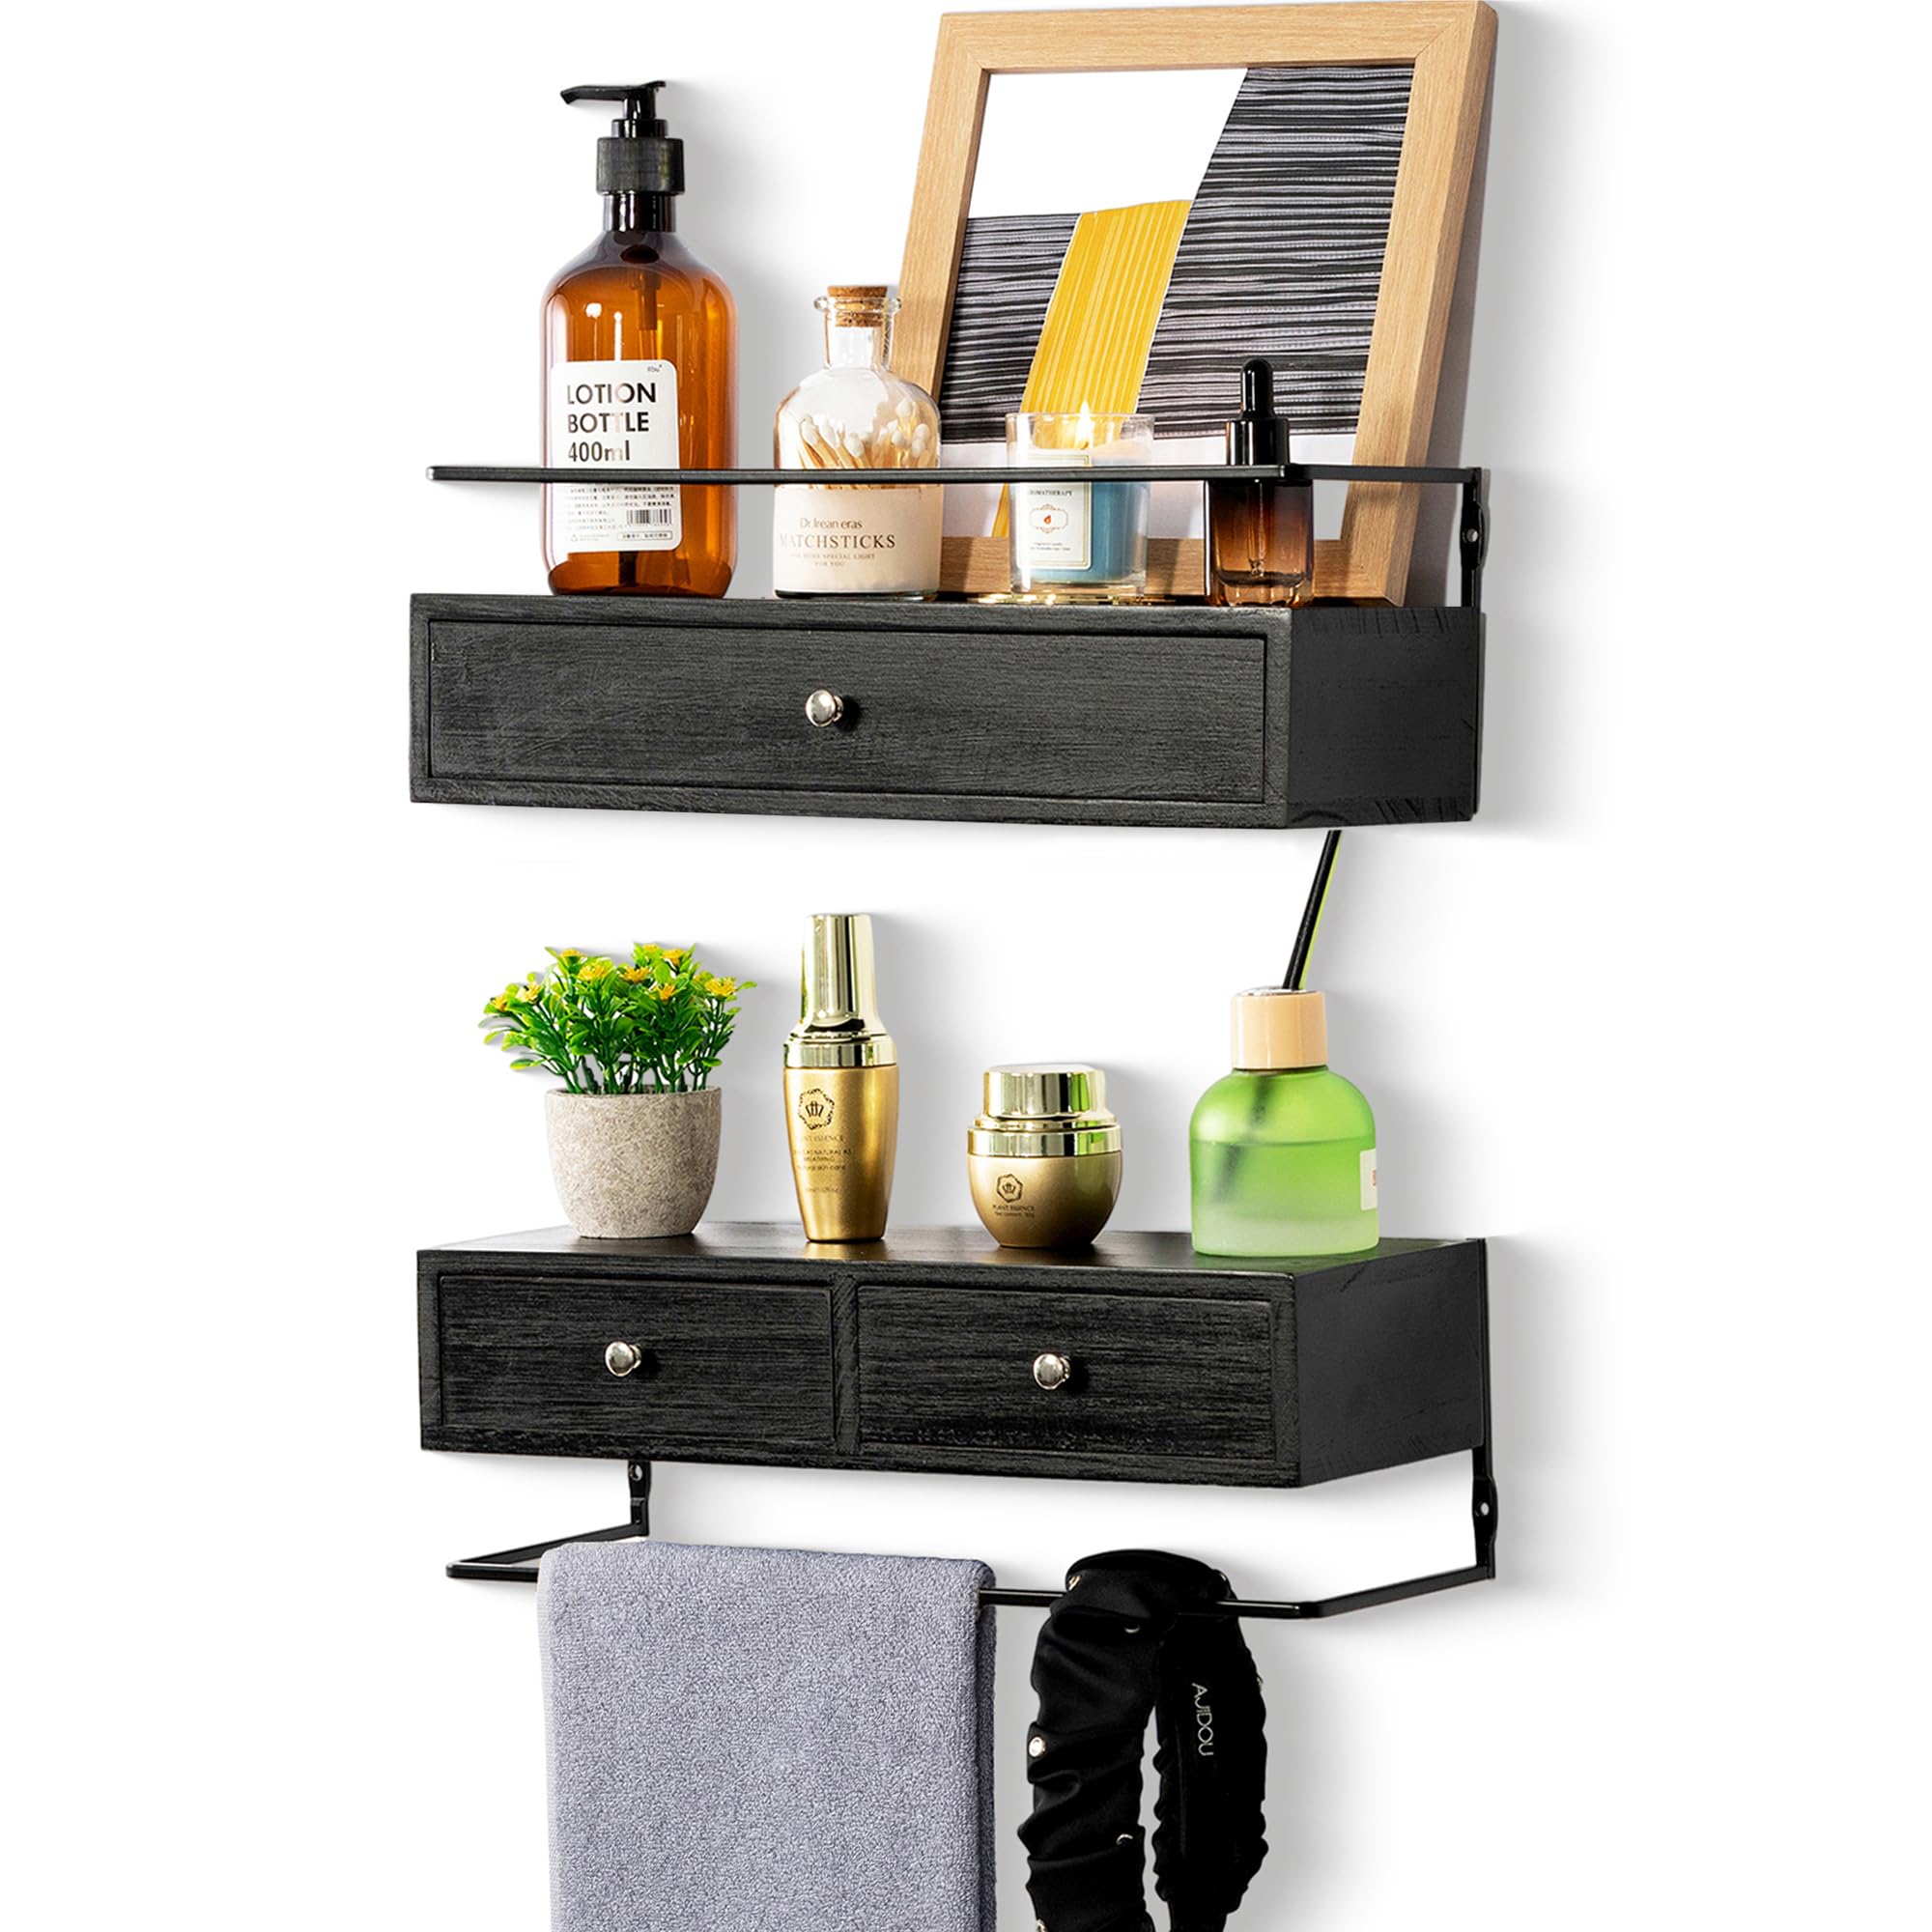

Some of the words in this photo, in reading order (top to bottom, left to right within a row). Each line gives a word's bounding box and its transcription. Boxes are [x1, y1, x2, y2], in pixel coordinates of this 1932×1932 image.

[567, 383, 656, 405] LOTION
[568, 412, 650, 433] BOTTLE
[568, 440, 630, 462] 400ml
[840, 520, 863, 528] eras
[781, 534, 895, 549] MATCHSTICKS
[1191, 1682, 1214, 1756] AJIDOU
